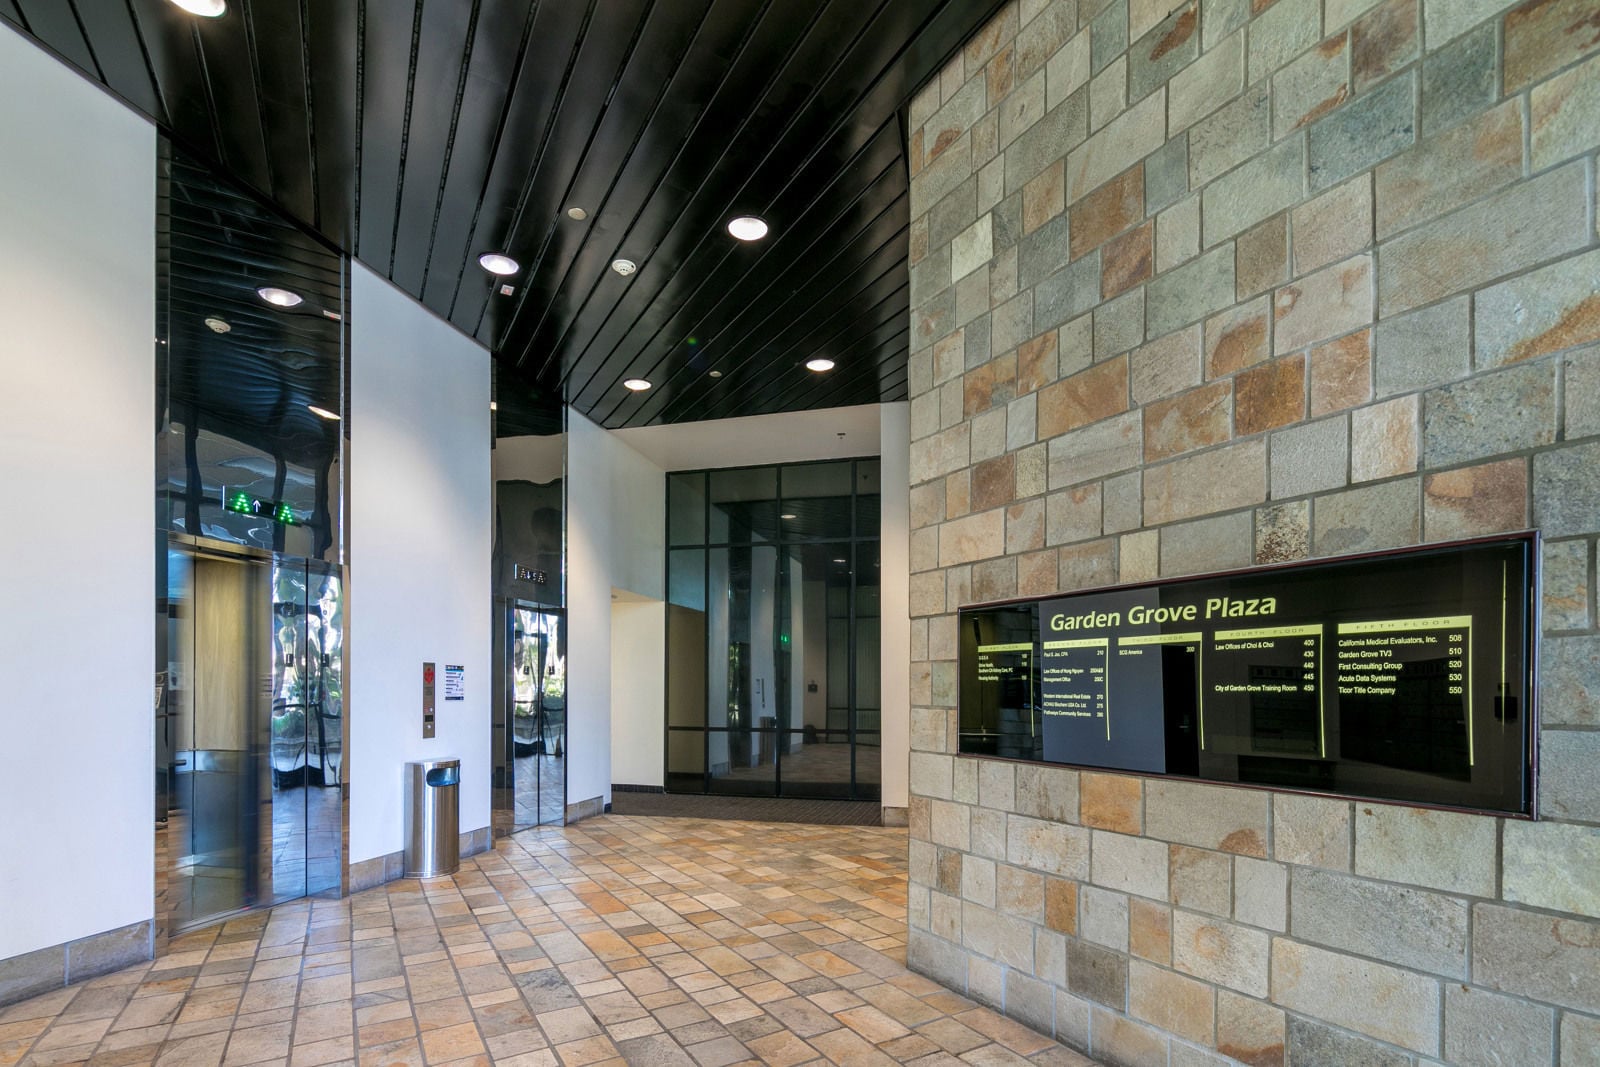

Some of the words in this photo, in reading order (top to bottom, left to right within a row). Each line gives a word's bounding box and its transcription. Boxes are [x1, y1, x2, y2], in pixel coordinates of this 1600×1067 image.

[1051, 611, 1120, 631] Garden
[1128, 605, 1197, 624] Grove
[1206, 598, 1277, 618] Plaza
[1390, 636, 1424, 644] Evaluators,
[1425, 635, 1438, 643] Inc.
[1360, 650, 1379, 658] Grove
[1379, 649, 1392, 657] TV3
[1448, 647, 1462, 655] 510
[1352, 662, 1382, 671] Consulting
[1383, 662, 1403, 671] Group
[1448, 660, 1462, 668] 520
[1338, 674, 1355, 682] Acute
[1355, 674, 1370, 682] Data
[1370, 674, 1396, 683] Systems
[1448, 673, 1462, 681] 530
[1215, 685, 1224, 693] City
[1261, 685, 1281, 693] Training
[1339, 686, 1353, 694] Ticor
[1353, 686, 1366, 694] Title
[1367, 686, 1396, 695] Company
[1448, 686, 1462, 694] 550
